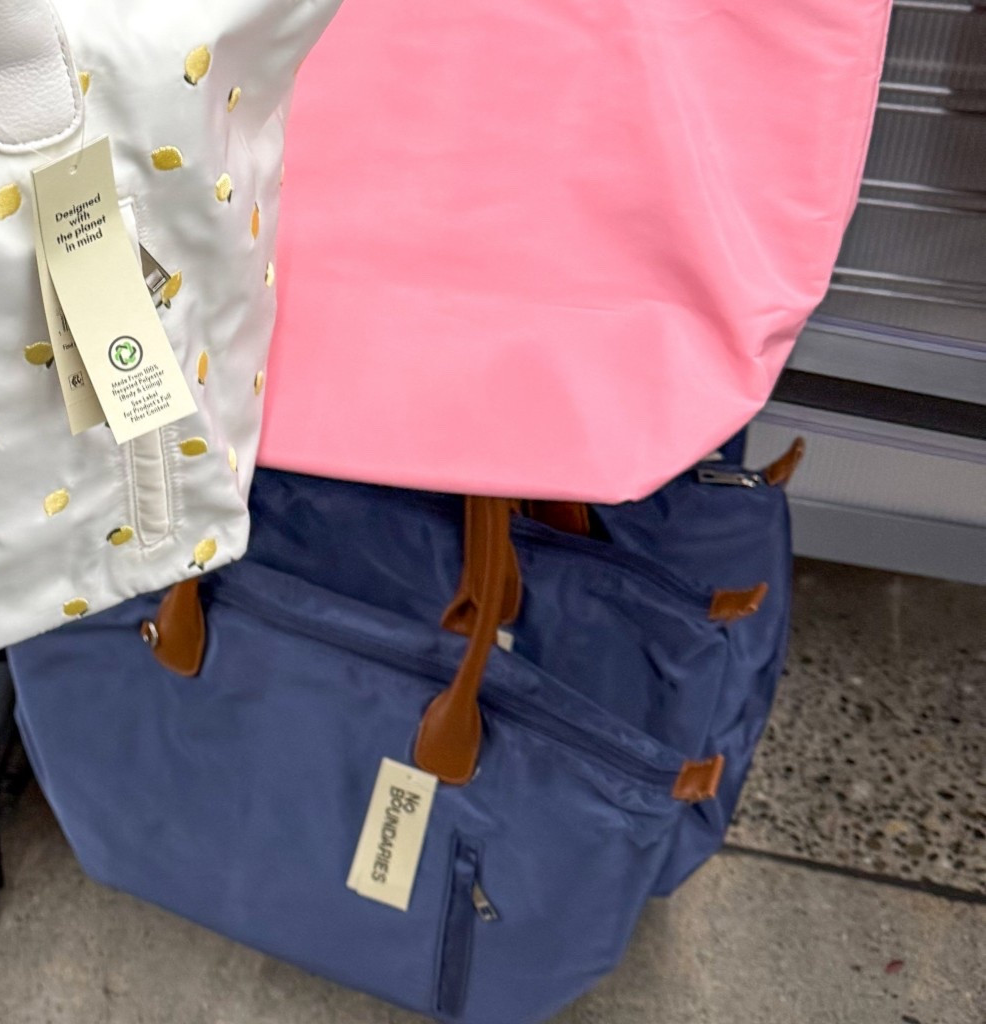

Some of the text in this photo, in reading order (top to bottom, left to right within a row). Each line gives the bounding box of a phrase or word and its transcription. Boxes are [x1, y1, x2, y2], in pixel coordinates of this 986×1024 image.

[55, 192, 101, 223] Designed
[69, 211, 91, 227] with
[56, 214, 106, 245] the planet
[65, 227, 103, 253] in mind
[111, 364, 159, 389] Made From 100%
[111, 369, 164, 397] Recycled Polyester
[131, 390, 159, 407] See Label
[403, 790, 421, 813] NO
[371, 785, 405, 884] BOUNDARIES
